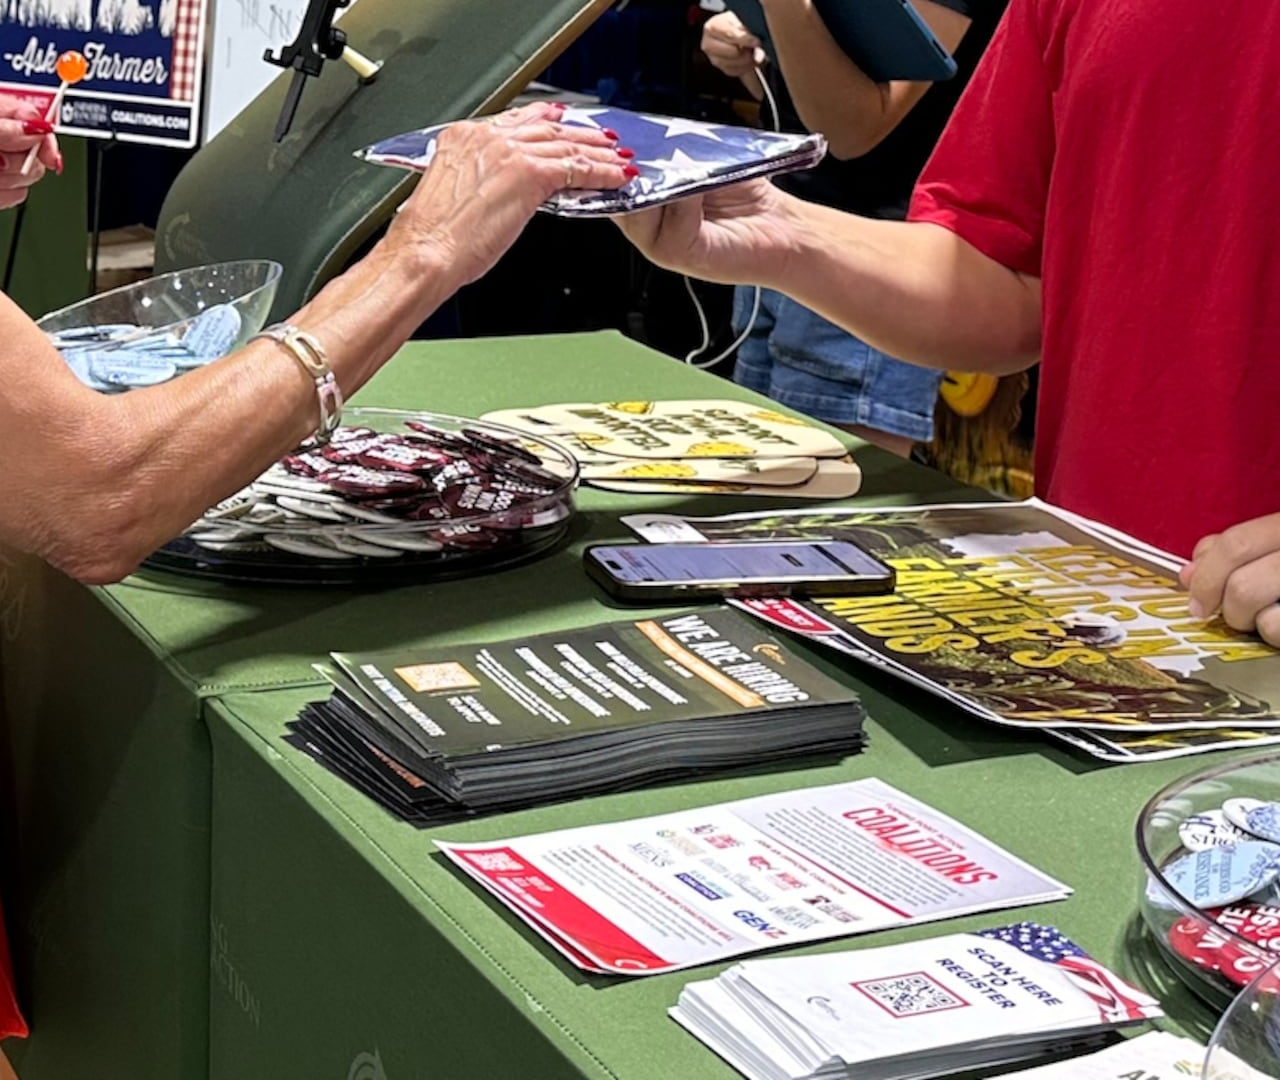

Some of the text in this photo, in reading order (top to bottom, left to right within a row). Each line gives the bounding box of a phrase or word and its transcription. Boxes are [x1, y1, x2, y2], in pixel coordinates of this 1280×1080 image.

[83, 41, 169, 86] Farmer
[110, 109, 189, 131] COALITIONS.COM
[936, 554, 1150, 622] FIELDS
[1010, 542, 1182, 590] KEEP
[663, 615, 720, 645] WE
[808, 594, 990, 653] ANDS
[884, 555, 1117, 669] FARMER'S
[688, 641, 753, 665] ARE
[721, 662, 809, 703] HIRING
[842, 806, 999, 885] COALITIONS
[935, 956, 1016, 1010] REGISTER
[968, 946, 1064, 1008] SCAN HERE
[981, 969, 1007, 990] TO
